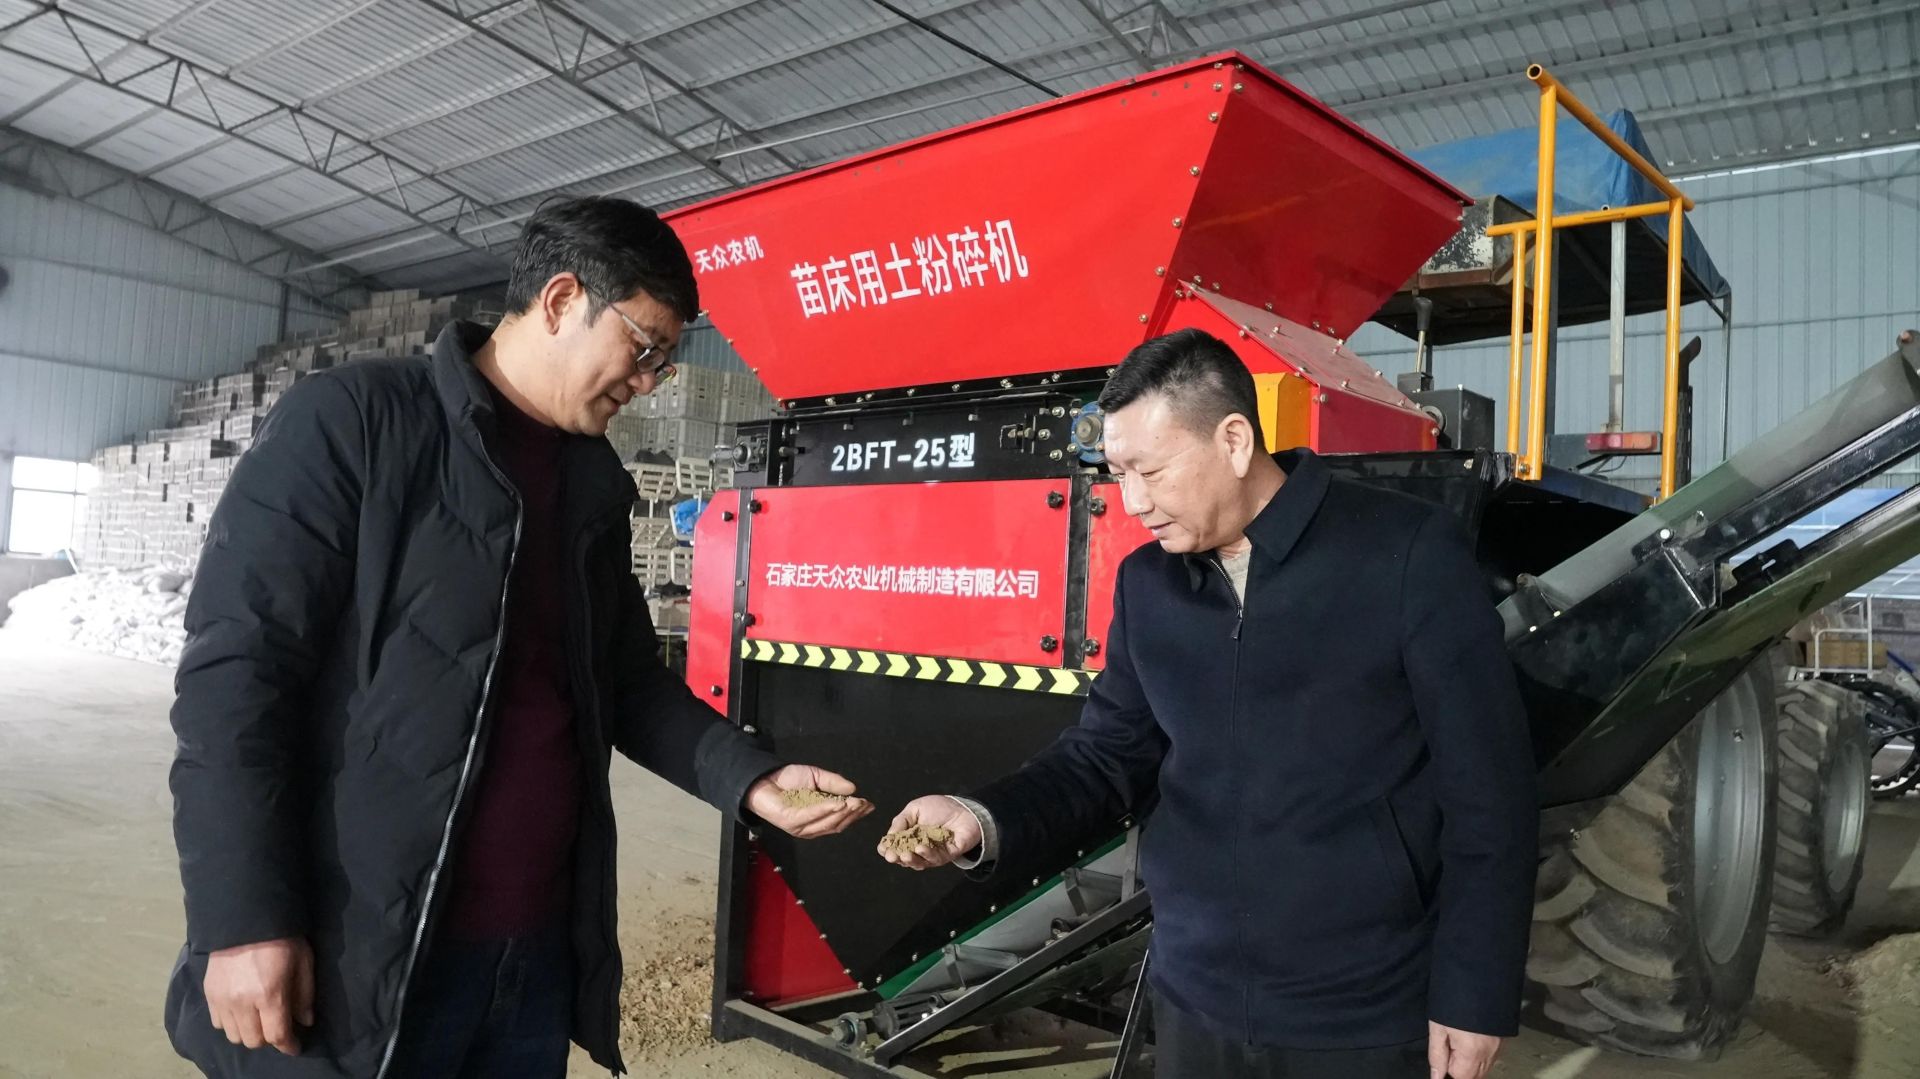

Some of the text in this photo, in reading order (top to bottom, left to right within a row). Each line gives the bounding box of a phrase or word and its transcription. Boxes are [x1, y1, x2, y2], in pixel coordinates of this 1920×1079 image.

[694, 235, 764, 273] 天众农机
[790, 219, 1028, 318] 苗床用土粉碎机
[831, 432, 975, 471] 2BFT-25型
[766, 562, 1039, 598] 石家庄天众农业机械制造有限公司
